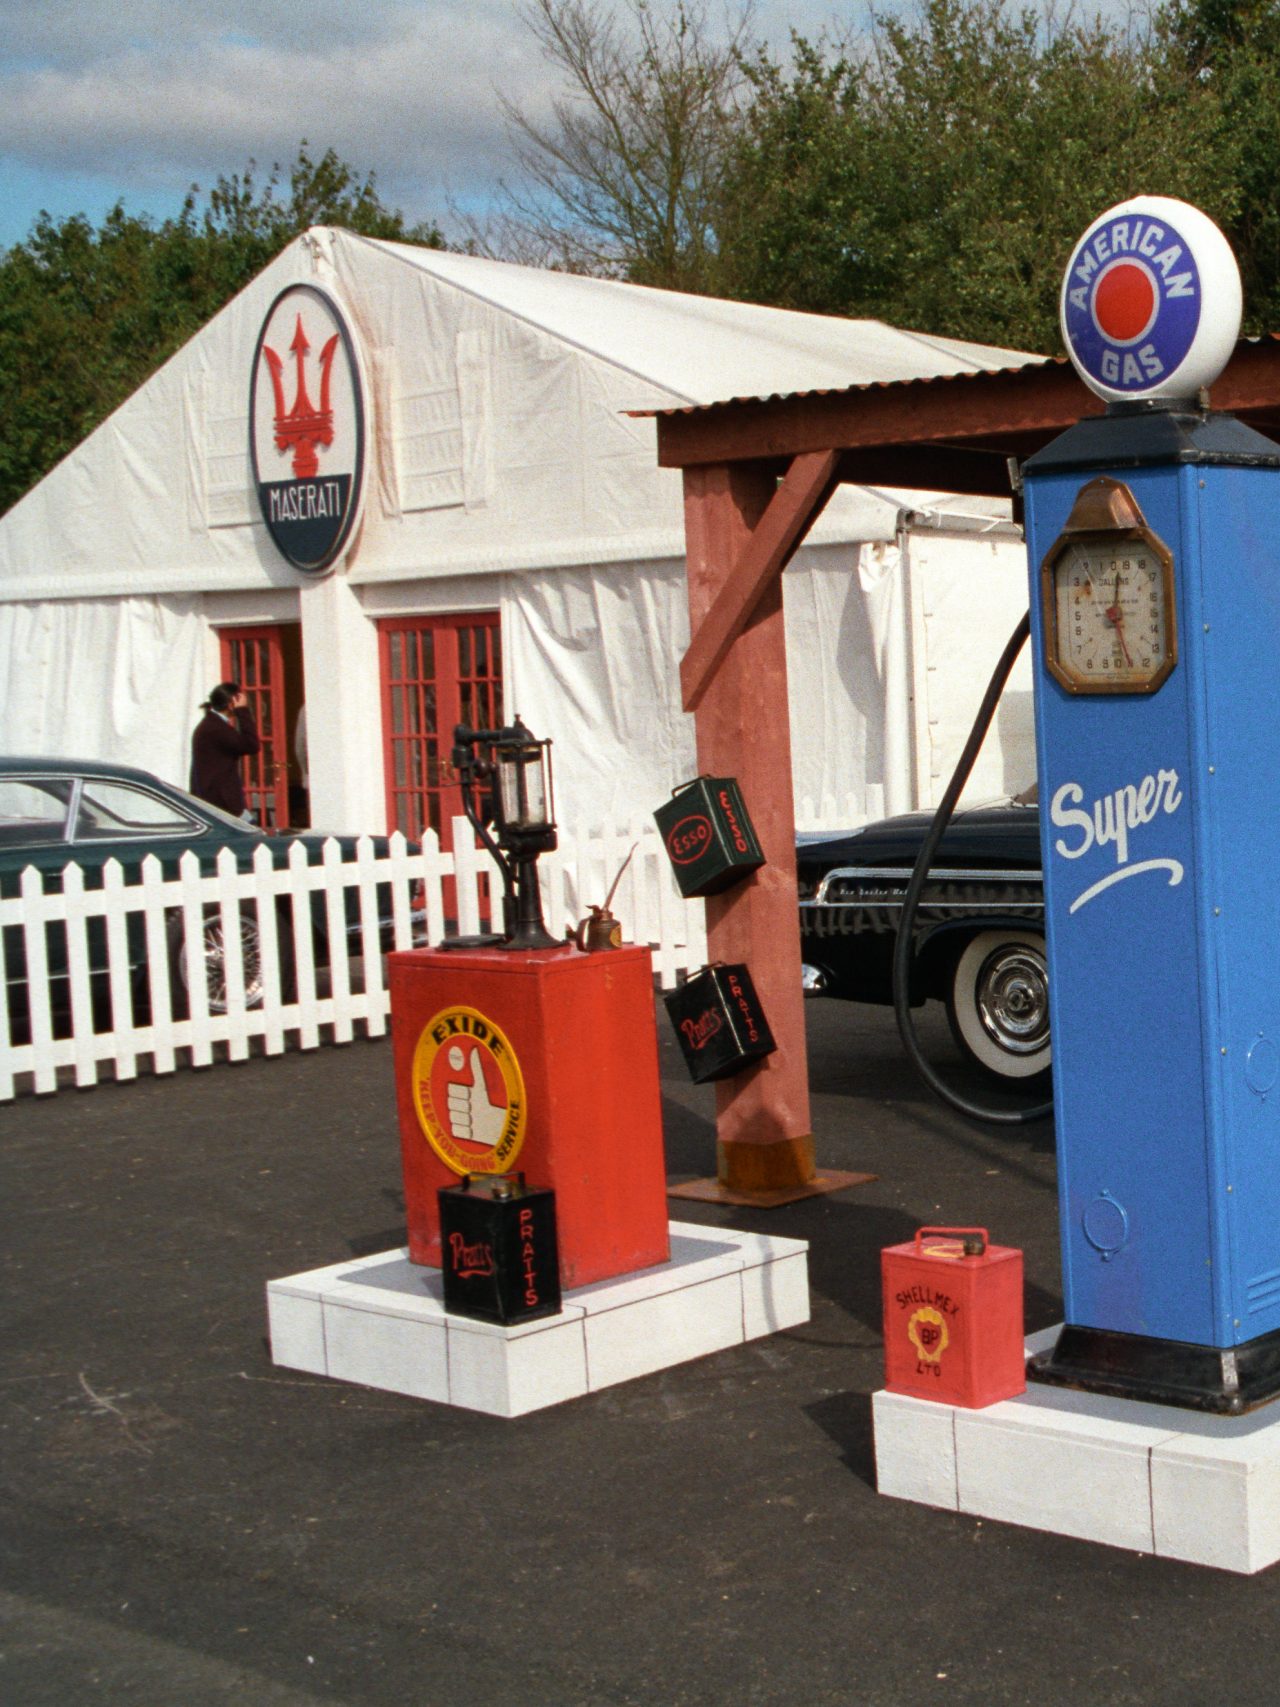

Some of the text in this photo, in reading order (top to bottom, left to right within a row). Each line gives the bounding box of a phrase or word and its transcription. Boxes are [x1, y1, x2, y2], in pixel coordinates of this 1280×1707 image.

[1069, 221, 1194, 311] AMERICAN
[1101, 344, 1165, 384] GAS
[270, 482, 340, 523] MASERATI
[719, 791, 748, 853] ESSO
[1051, 768, 1182, 864] Super
[431, 1016, 503, 1057] EXIDE
[728, 976, 758, 1042] PRATTS
[496, 1099, 521, 1162] SERVICE
[449, 1232, 494, 1273] Pratts
[520, 1209, 538, 1306] PRATTS
[921, 1328, 939, 1345] BP
